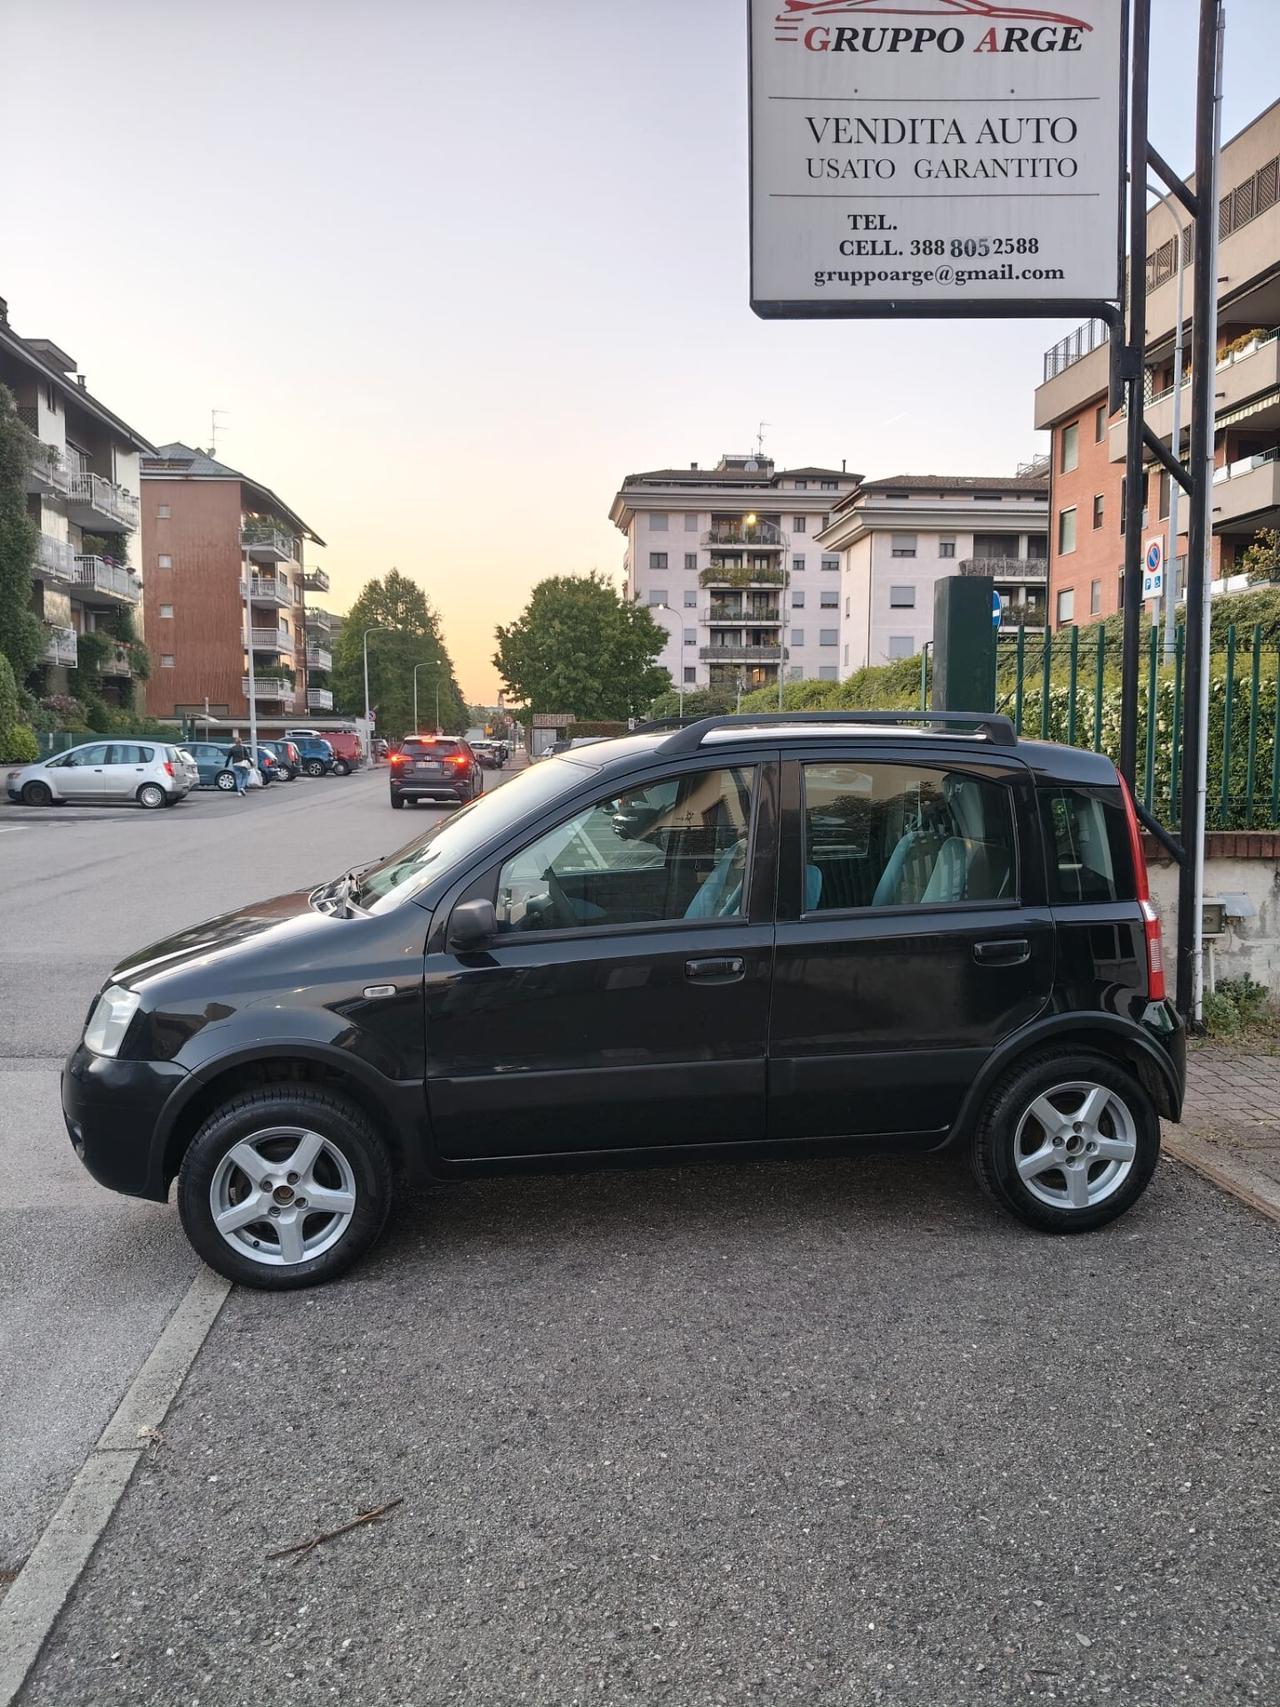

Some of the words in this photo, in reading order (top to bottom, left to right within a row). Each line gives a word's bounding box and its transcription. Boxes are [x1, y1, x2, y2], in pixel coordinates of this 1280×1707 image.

[804, 27, 965, 53] GRUPPO
[974, 26, 1084, 53] ARGE
[804, 117, 967, 145] VENDITA
[975, 117, 1078, 145] AUTO
[805, 158, 896, 180] USATO
[913, 158, 1079, 180] GARANTITO
[847, 214, 898, 231] TEL.
[838, 240, 904, 256] CELL.
[910, 240, 945, 256] 388
[992, 238, 1040, 255] 2588
[814, 264, 1066, 287] gruppoarge@gmail.com
